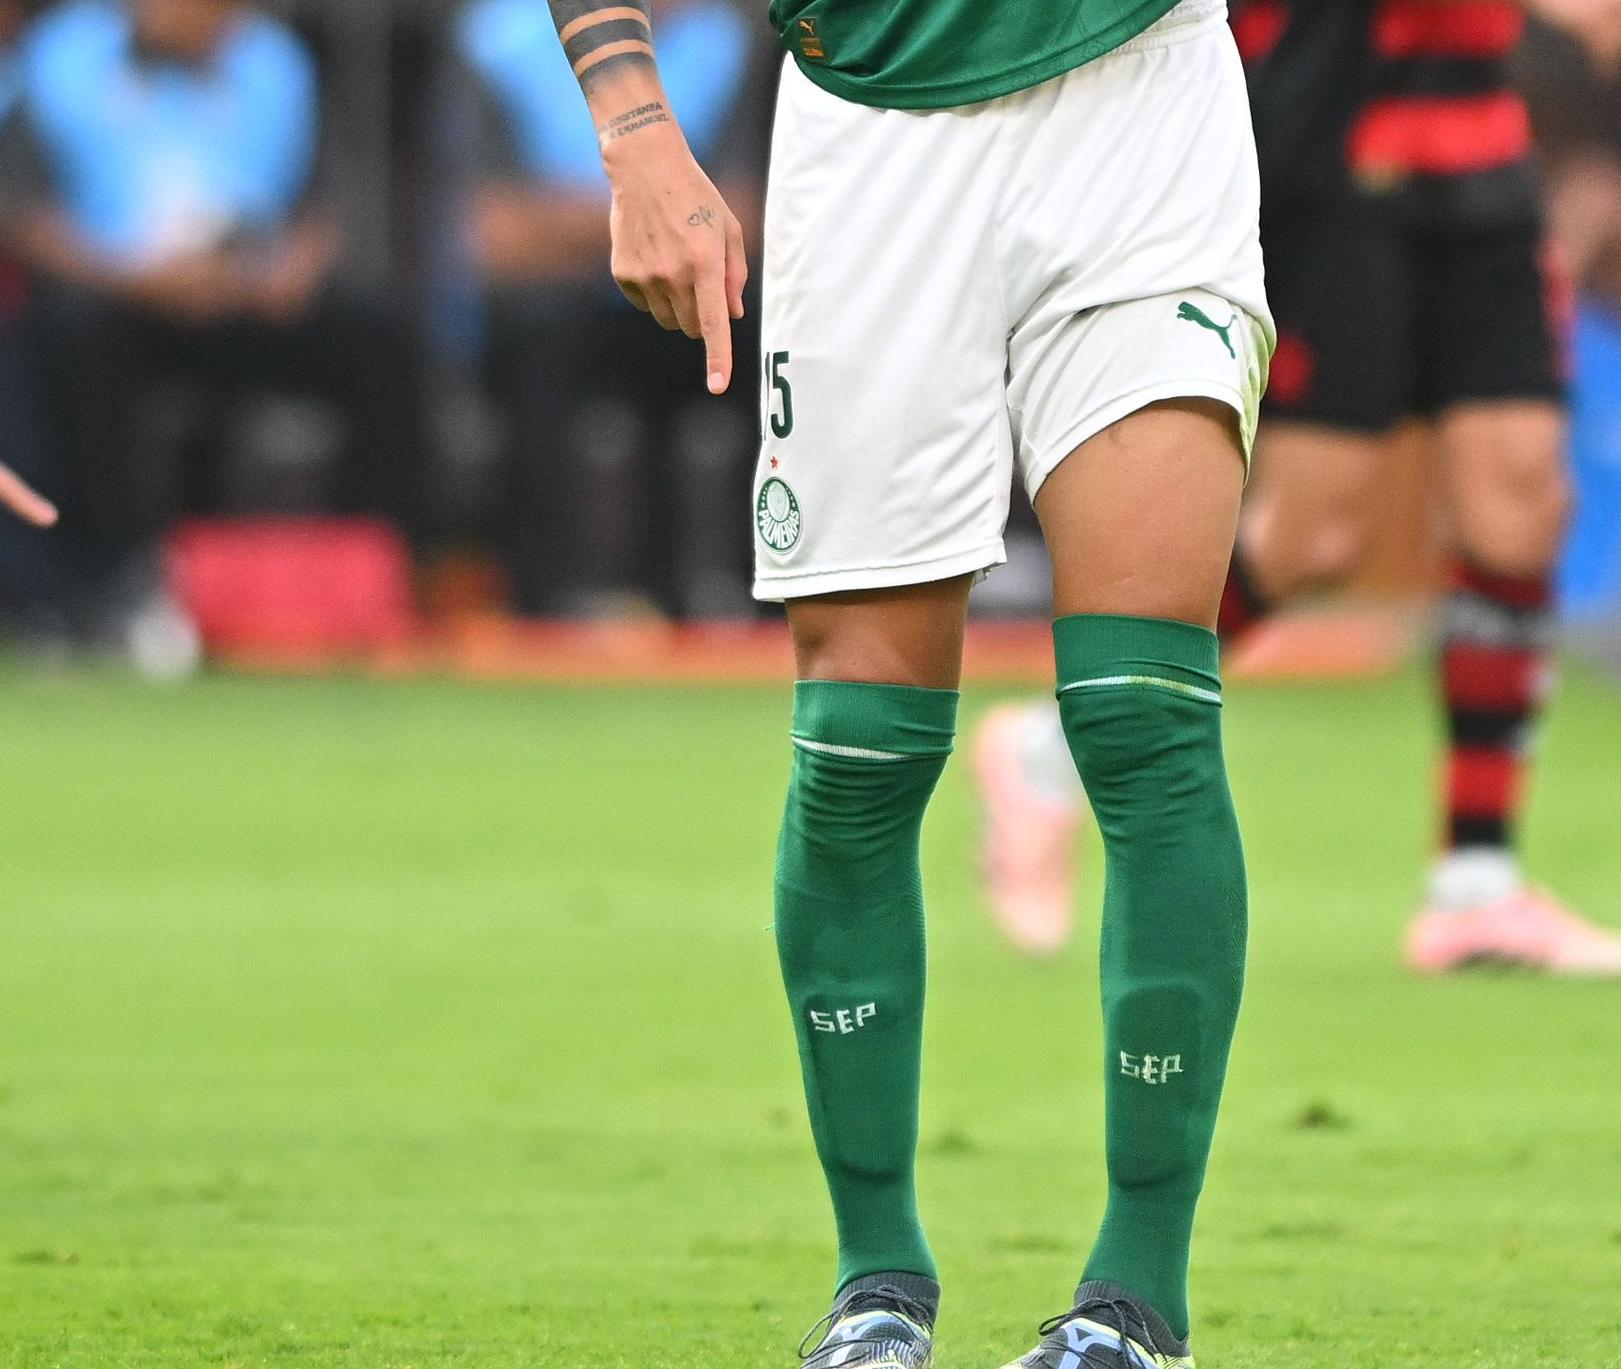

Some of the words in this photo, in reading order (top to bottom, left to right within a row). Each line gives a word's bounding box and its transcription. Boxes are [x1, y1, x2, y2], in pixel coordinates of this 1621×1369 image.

[757, 508, 801, 550] PALMEIRAS
[810, 1002, 878, 1035] SEP
[1120, 1050, 1185, 1085] SEP
